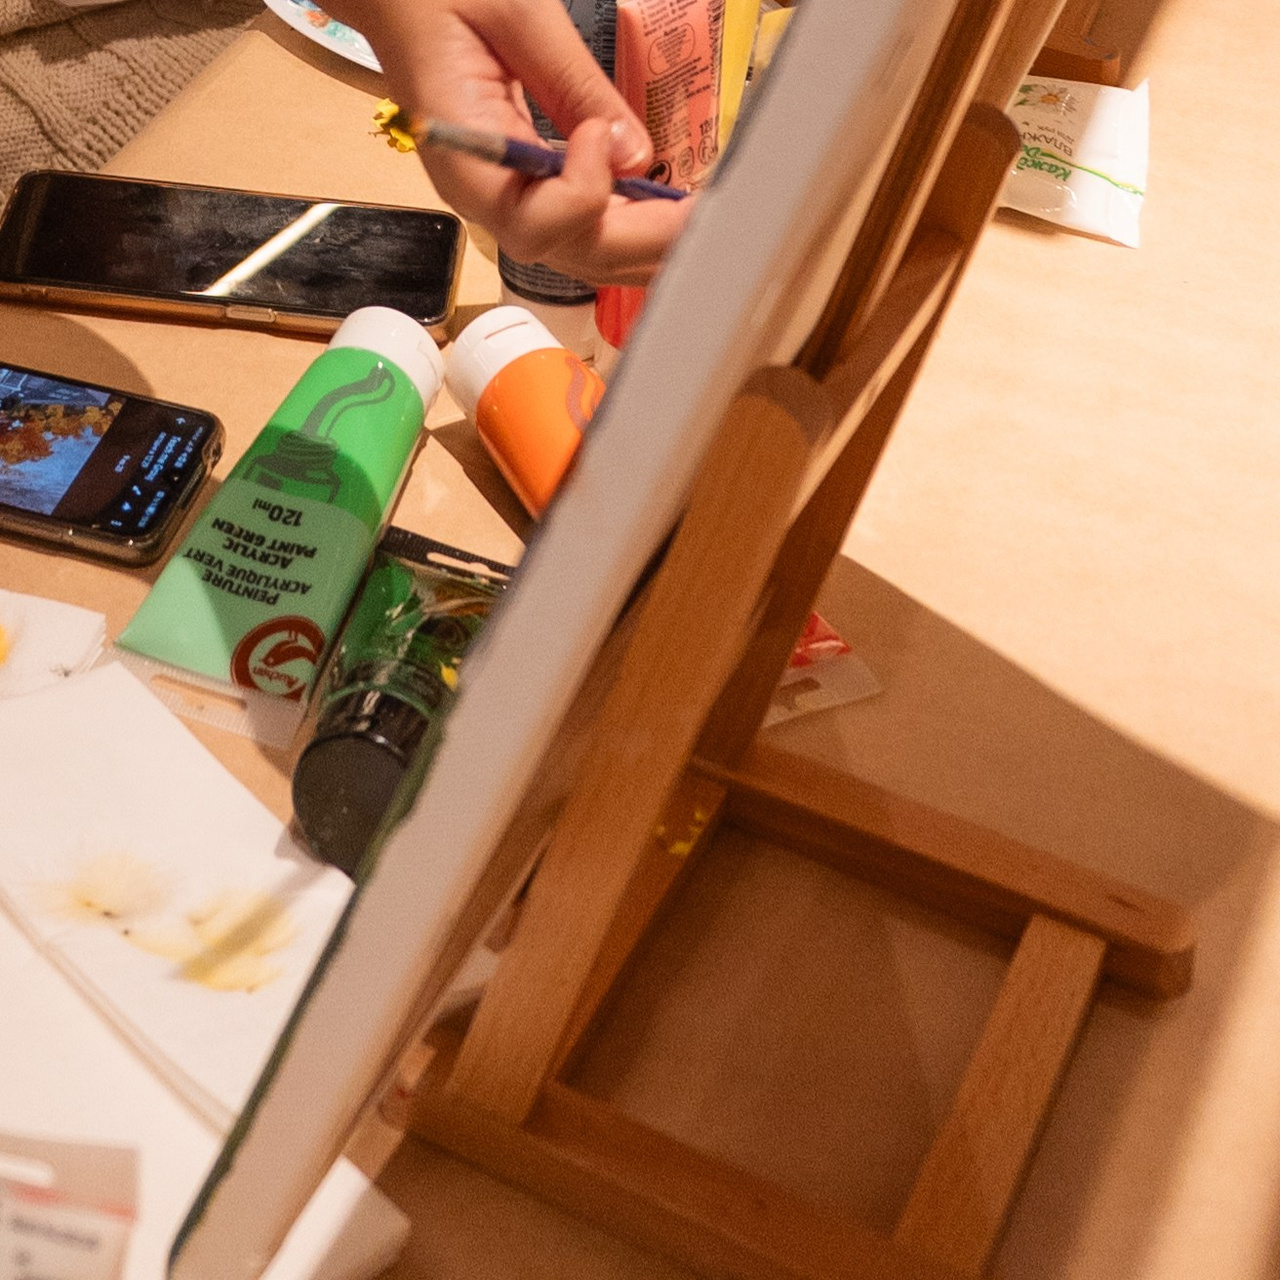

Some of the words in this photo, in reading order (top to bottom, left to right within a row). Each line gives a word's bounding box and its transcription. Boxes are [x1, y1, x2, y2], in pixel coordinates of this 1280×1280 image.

[252, 497, 303, 528] 120ml
[211, 517, 266, 546] GREEN
[182, 546, 224, 572] VERT
[221, 536, 294, 569] ACRYLIC
[266, 539, 318, 559] PAINT
[201, 569, 281, 606] PEINTURE
[225, 563, 313, 595] ACRYLIQUE
